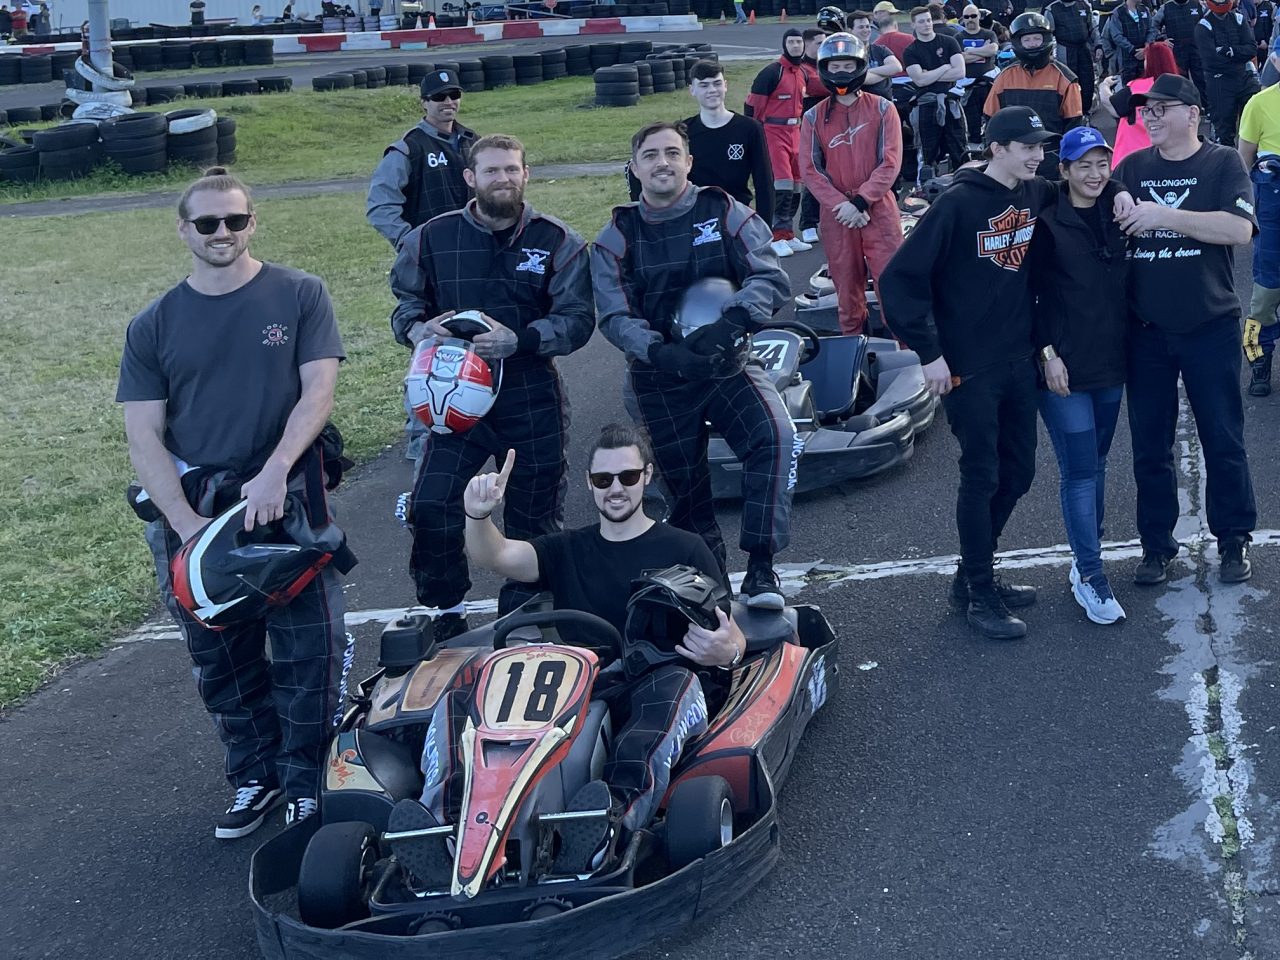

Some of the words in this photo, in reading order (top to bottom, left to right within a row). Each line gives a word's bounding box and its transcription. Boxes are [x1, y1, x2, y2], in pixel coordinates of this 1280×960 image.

[427, 151, 448, 168] 64
[1140, 177, 1198, 188] WOLLONGONG
[1138, 230, 1154, 239] ART
[1158, 247, 1173, 259] the
[1175, 247, 1202, 258] dream
[495, 660, 567, 723] 18
